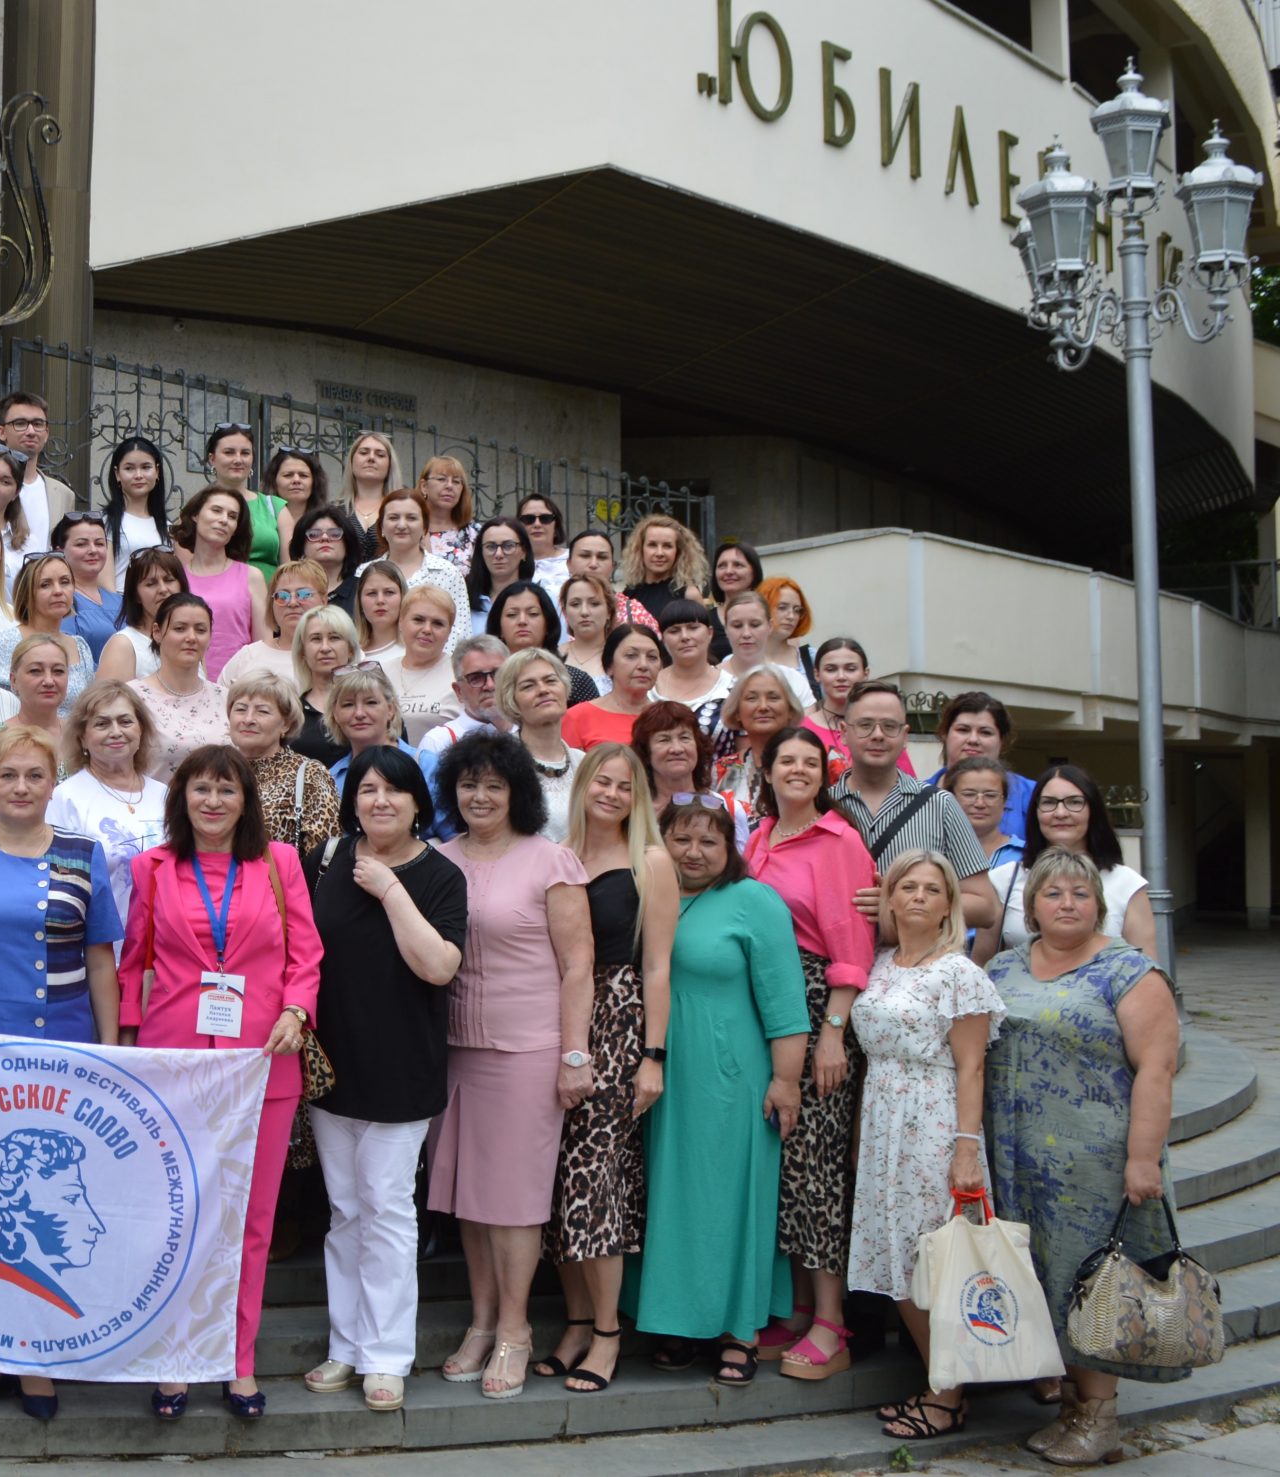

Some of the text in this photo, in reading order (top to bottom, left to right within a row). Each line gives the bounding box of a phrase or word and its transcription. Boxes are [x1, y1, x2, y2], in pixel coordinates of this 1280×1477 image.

[74, 1067, 161, 1140] ФЕСТИВАЛЬ
[74, 1097, 138, 1159] СЛОВО
[31, 1151, 185, 1353] МЕЖДУНАРОДНЫЙ ФЕСТИВАЛЬ
